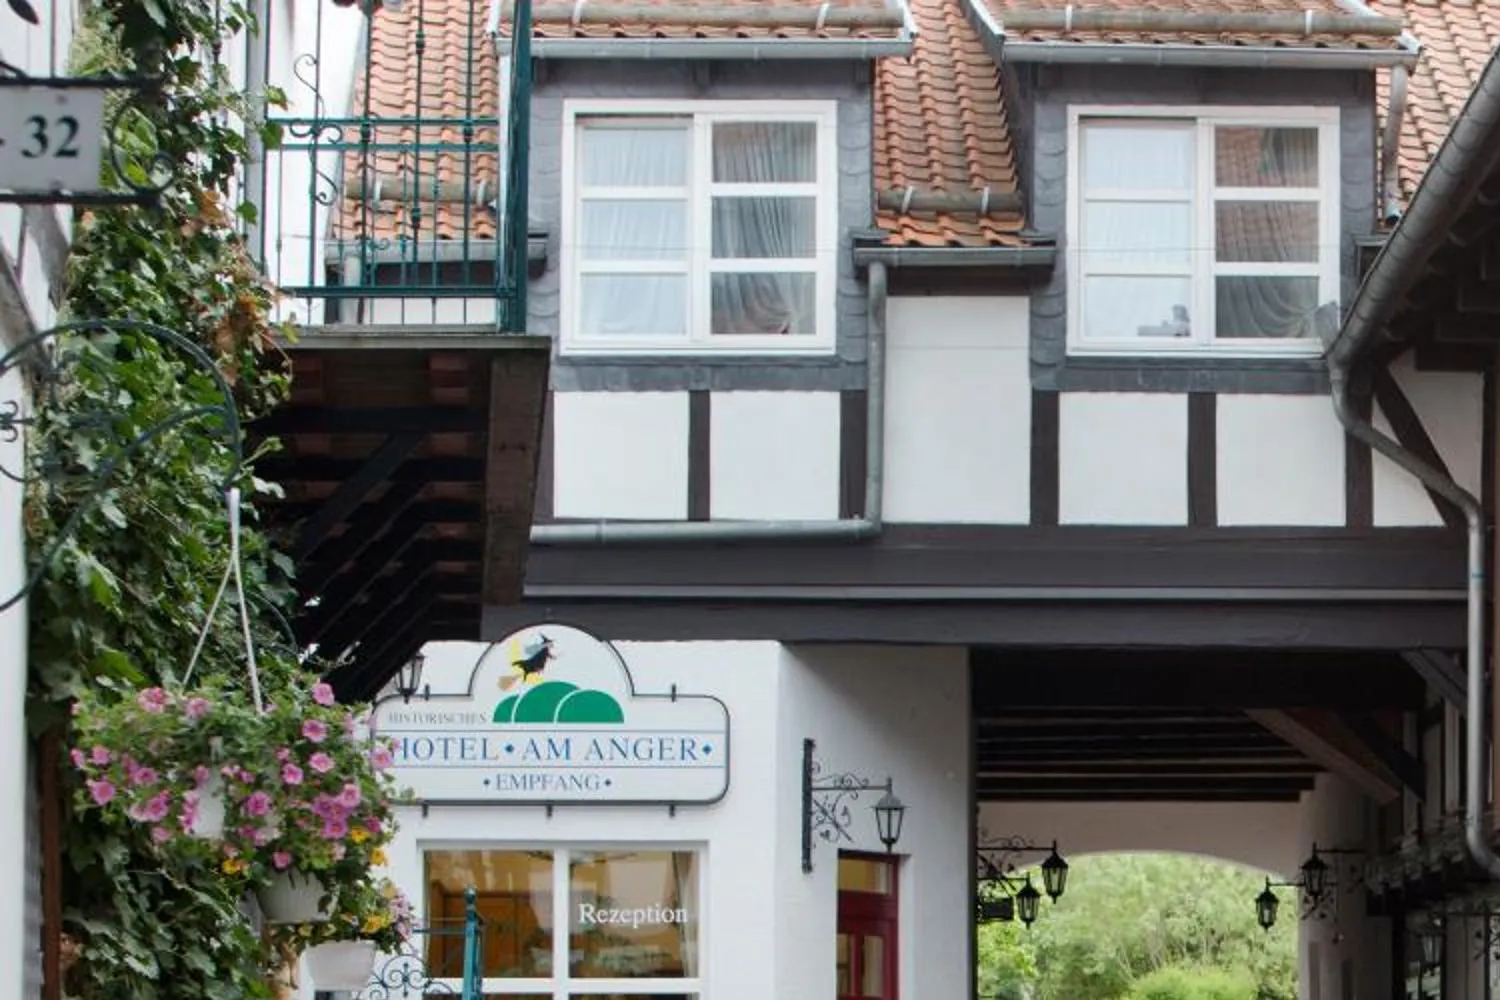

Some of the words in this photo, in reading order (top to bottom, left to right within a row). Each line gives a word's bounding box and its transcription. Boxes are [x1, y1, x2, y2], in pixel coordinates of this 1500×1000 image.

[21, 115, 79, 158] 32
[388, 712, 487, 724] HISTORISCHES
[390, 737, 498, 761] HOTEL
[522, 737, 571, 761] AM
[584, 737, 698, 761] ANGER
[496, 773, 600, 791] EMPFANG
[579, 903, 688, 928] Rezeption
